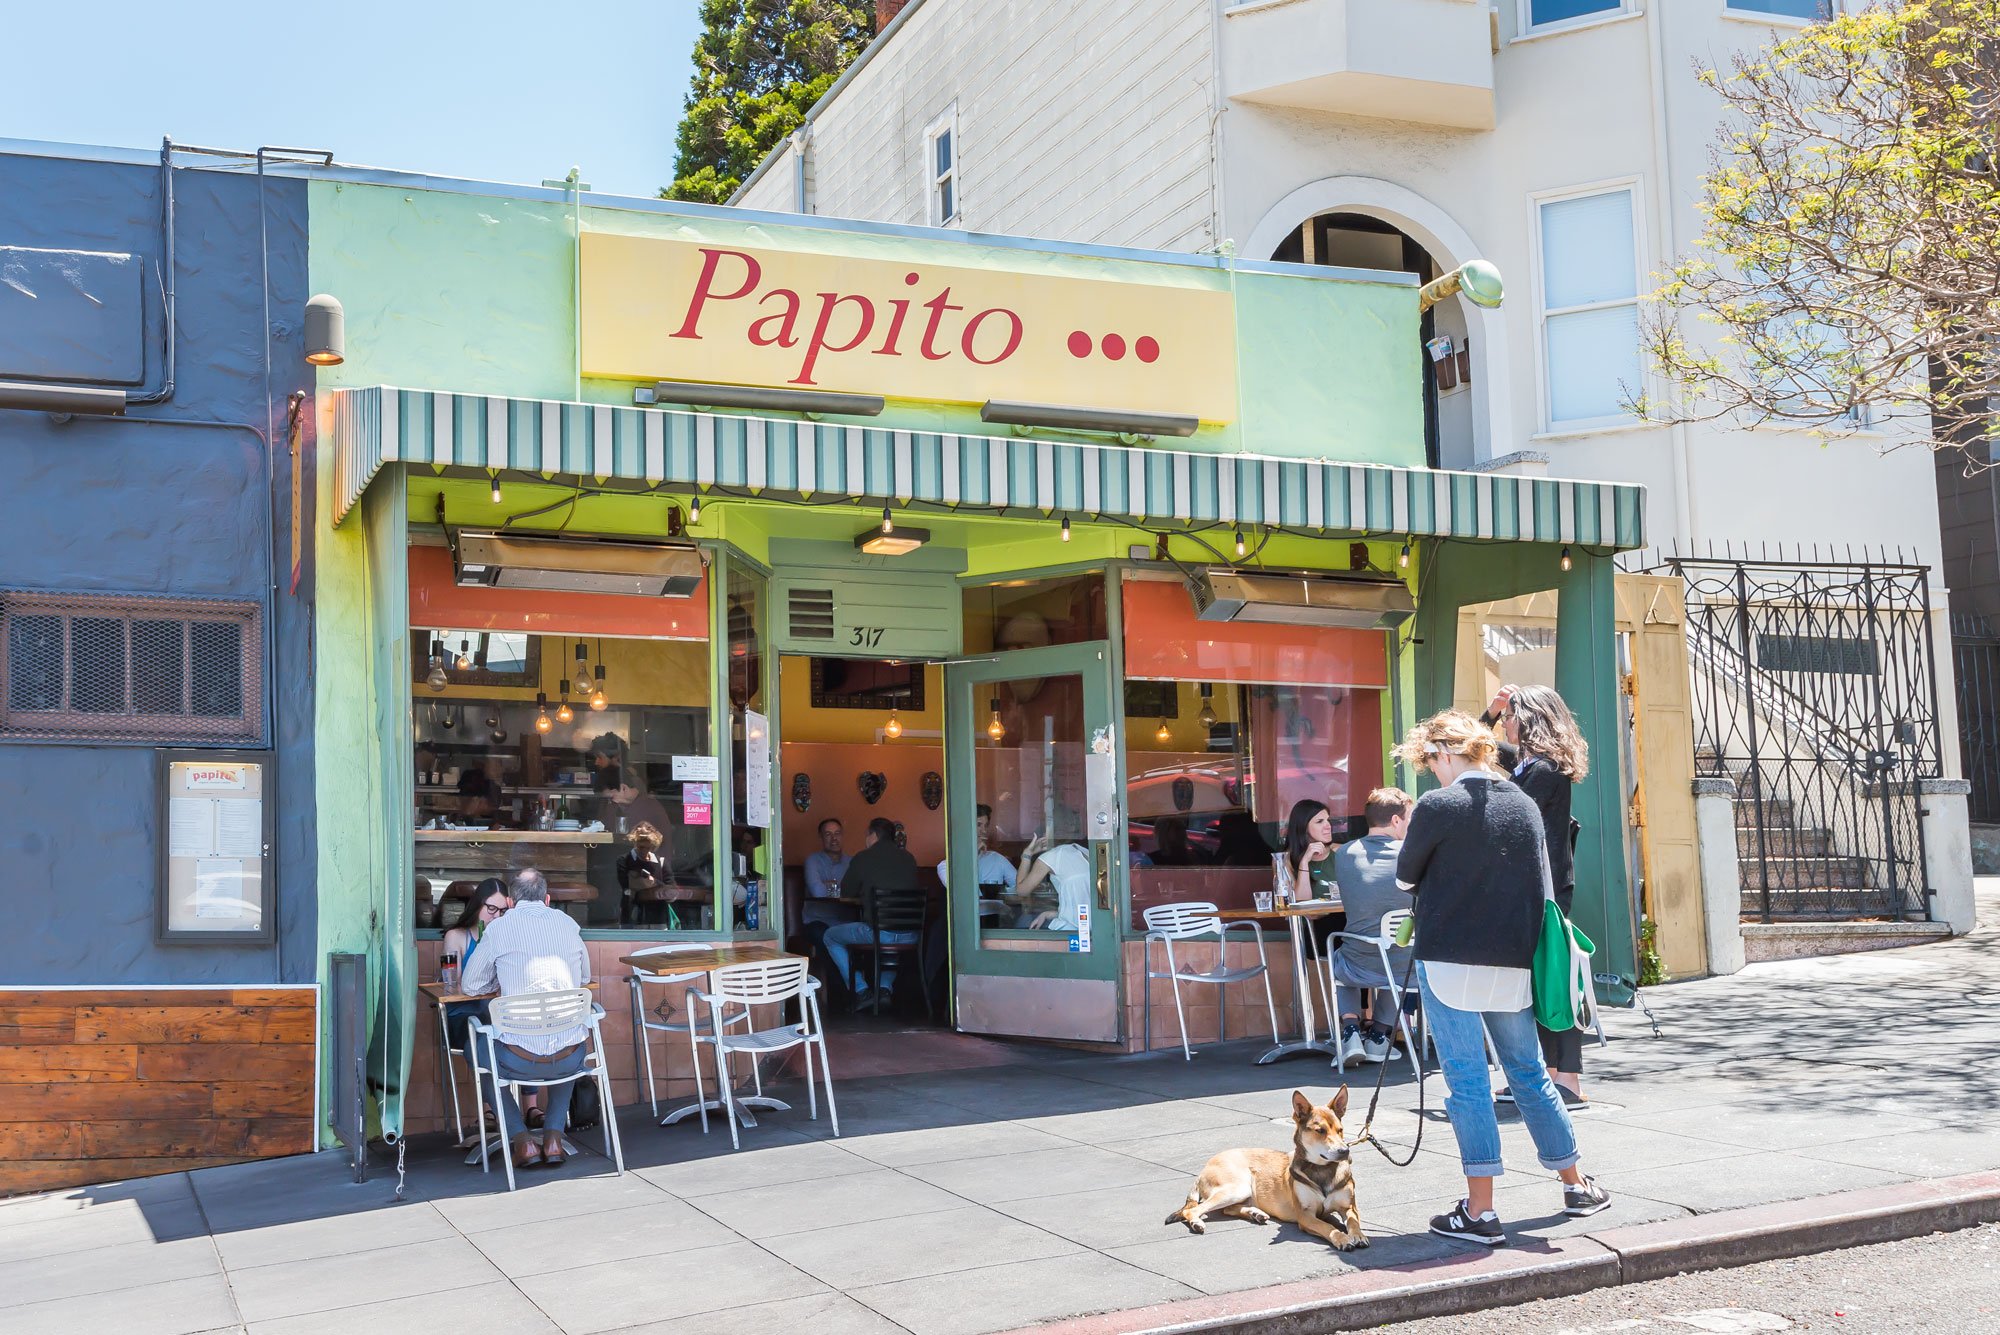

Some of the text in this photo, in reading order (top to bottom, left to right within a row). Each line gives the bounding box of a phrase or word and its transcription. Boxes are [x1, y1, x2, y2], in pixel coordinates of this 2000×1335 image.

[668, 247, 1024, 386] Papito
[850, 627, 885, 648] 317
[1449, 1215, 1464, 1230] N
